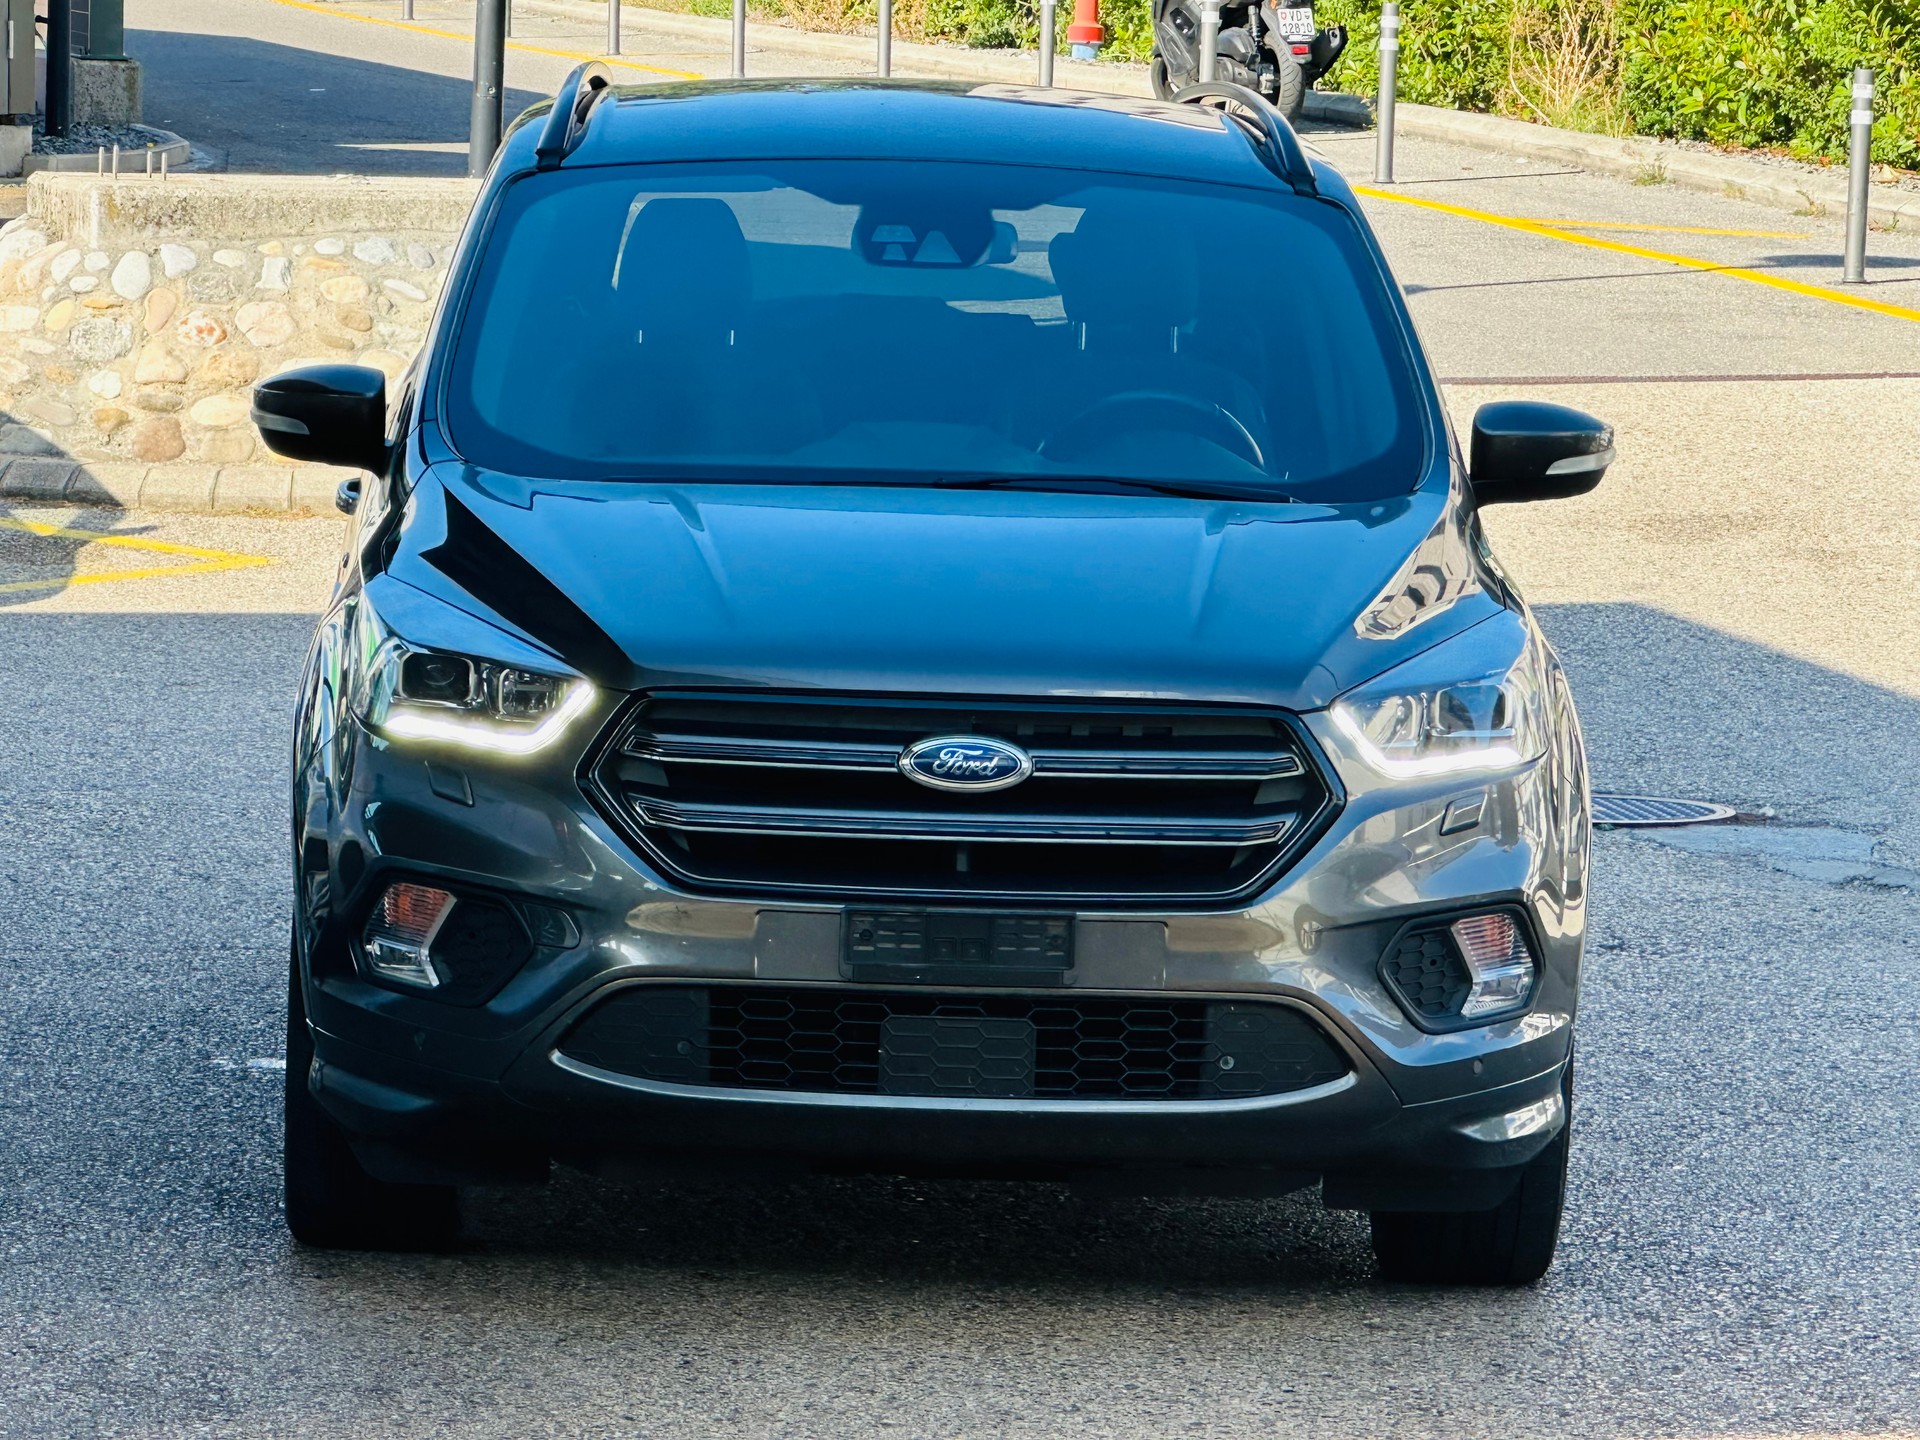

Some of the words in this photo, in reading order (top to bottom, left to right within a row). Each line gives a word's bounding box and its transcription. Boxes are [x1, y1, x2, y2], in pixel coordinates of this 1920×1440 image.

[1289, 10, 1302, 21] VD
[1282, 23, 1312, 33] 12810
[932, 747, 998, 776] Ford
